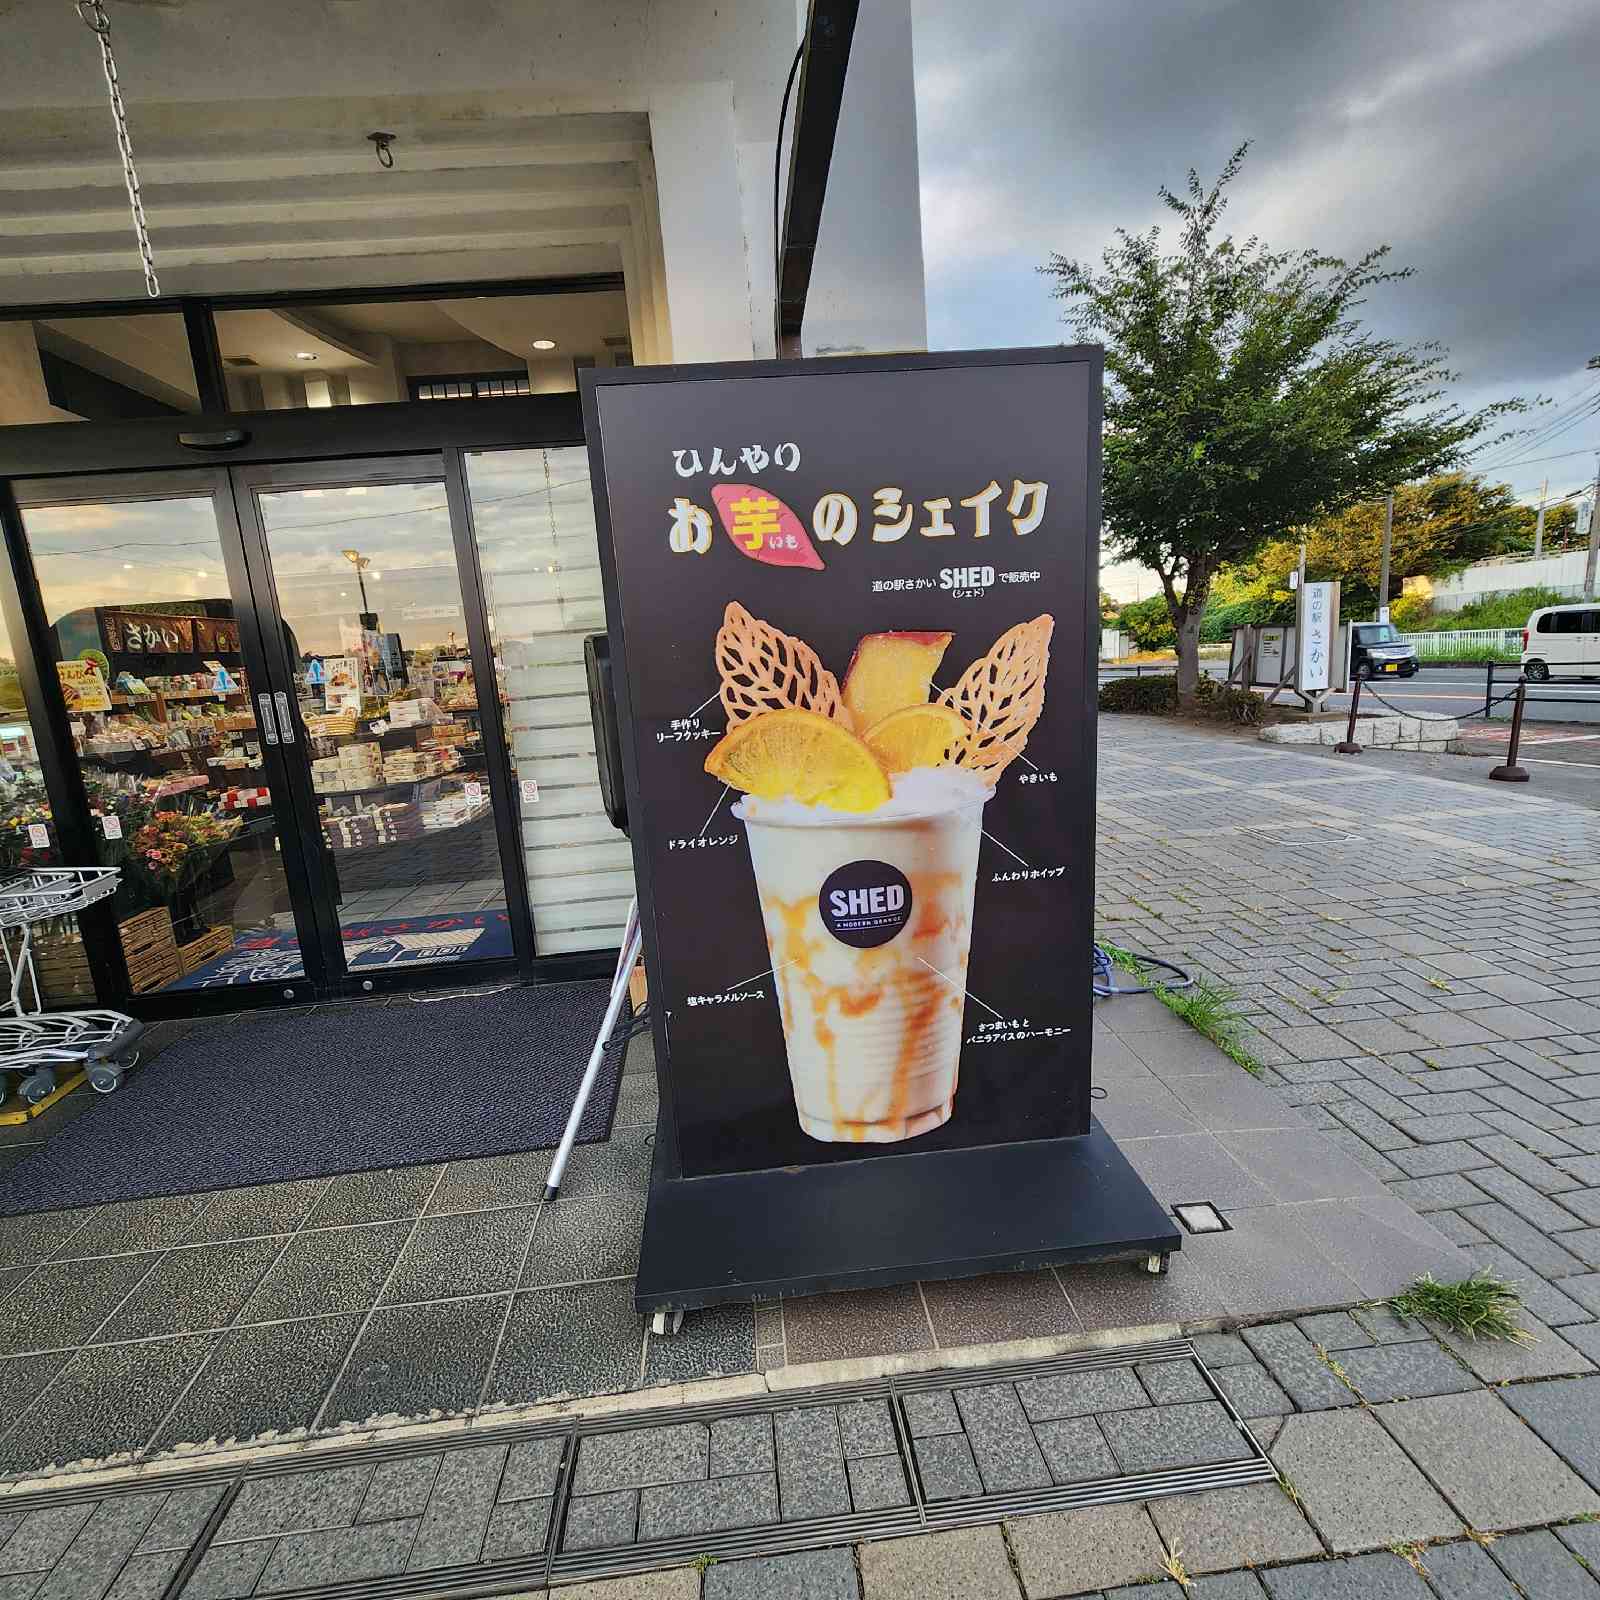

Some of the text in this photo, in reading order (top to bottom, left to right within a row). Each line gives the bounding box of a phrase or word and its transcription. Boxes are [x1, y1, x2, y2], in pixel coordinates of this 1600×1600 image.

[672, 443, 801, 478] ひんやり
[768, 533, 800, 550] いも
[872, 566, 1041, 593] 道の駅さかい SHED で販売中
[670, 718, 701, 730] 手作り
[656, 728, 721, 744] リーフクッキー
[1018, 771, 1058, 785] やきいも
[668, 834, 738, 851] ドライオレンジ
[991, 865, 1066, 882] ふんわりホイップ
[830, 884, 904, 917] SHED
[686, 989, 765, 1007] 塩キャラメルソース
